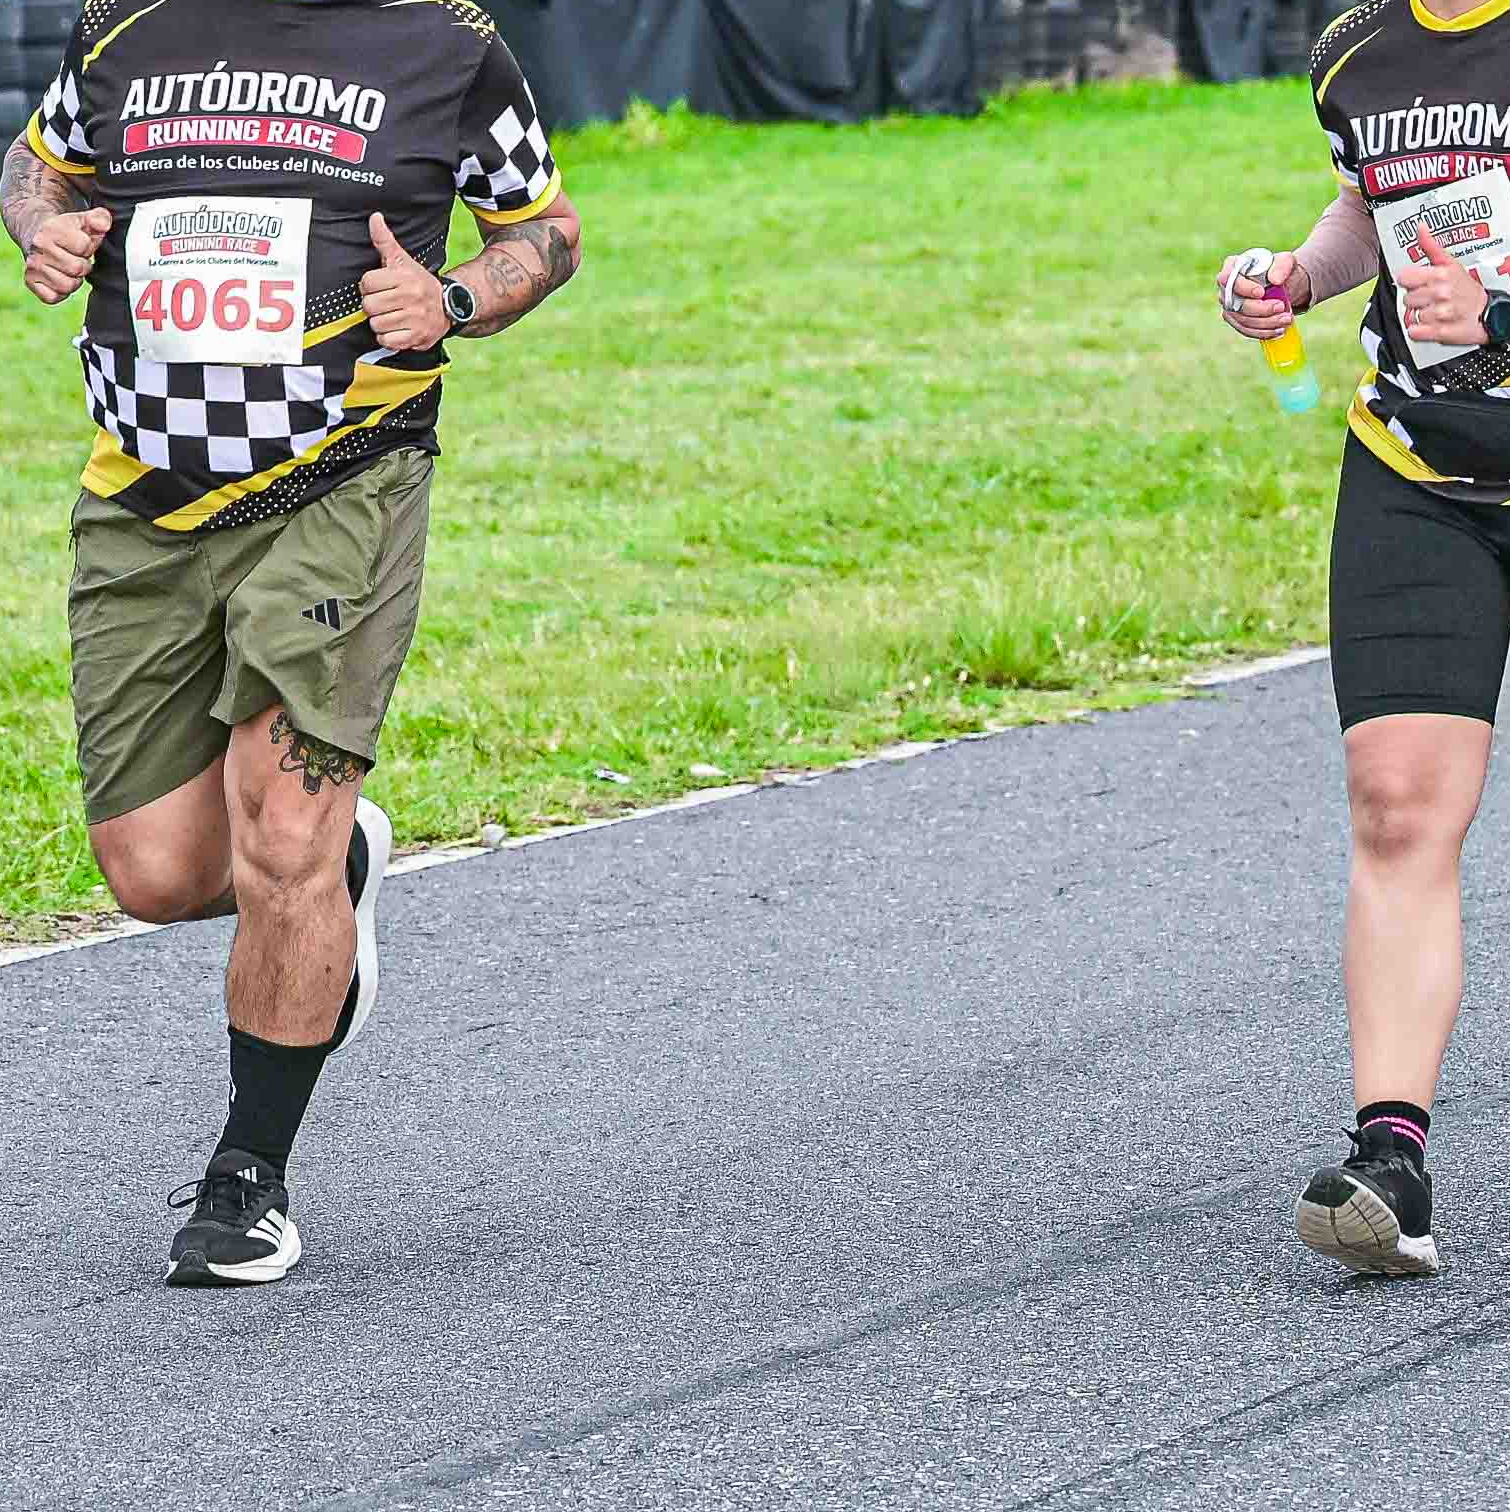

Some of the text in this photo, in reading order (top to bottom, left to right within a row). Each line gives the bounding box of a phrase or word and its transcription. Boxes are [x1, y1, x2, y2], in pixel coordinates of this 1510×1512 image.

[119, 60, 387, 132] AUTÓDROMO
[147, 119, 339, 153] RUNNING RACE
[109, 155, 384, 186] La Carrera de los Clubes del Noroeste
[1374, 155, 1450, 190] RUNNING
[153, 204, 282, 238] AUTÓDROMO
[1452, 226, 1478, 247] RACE
[171, 236, 259, 254] RUNNING RACE
[135, 278, 295, 332] 4065
